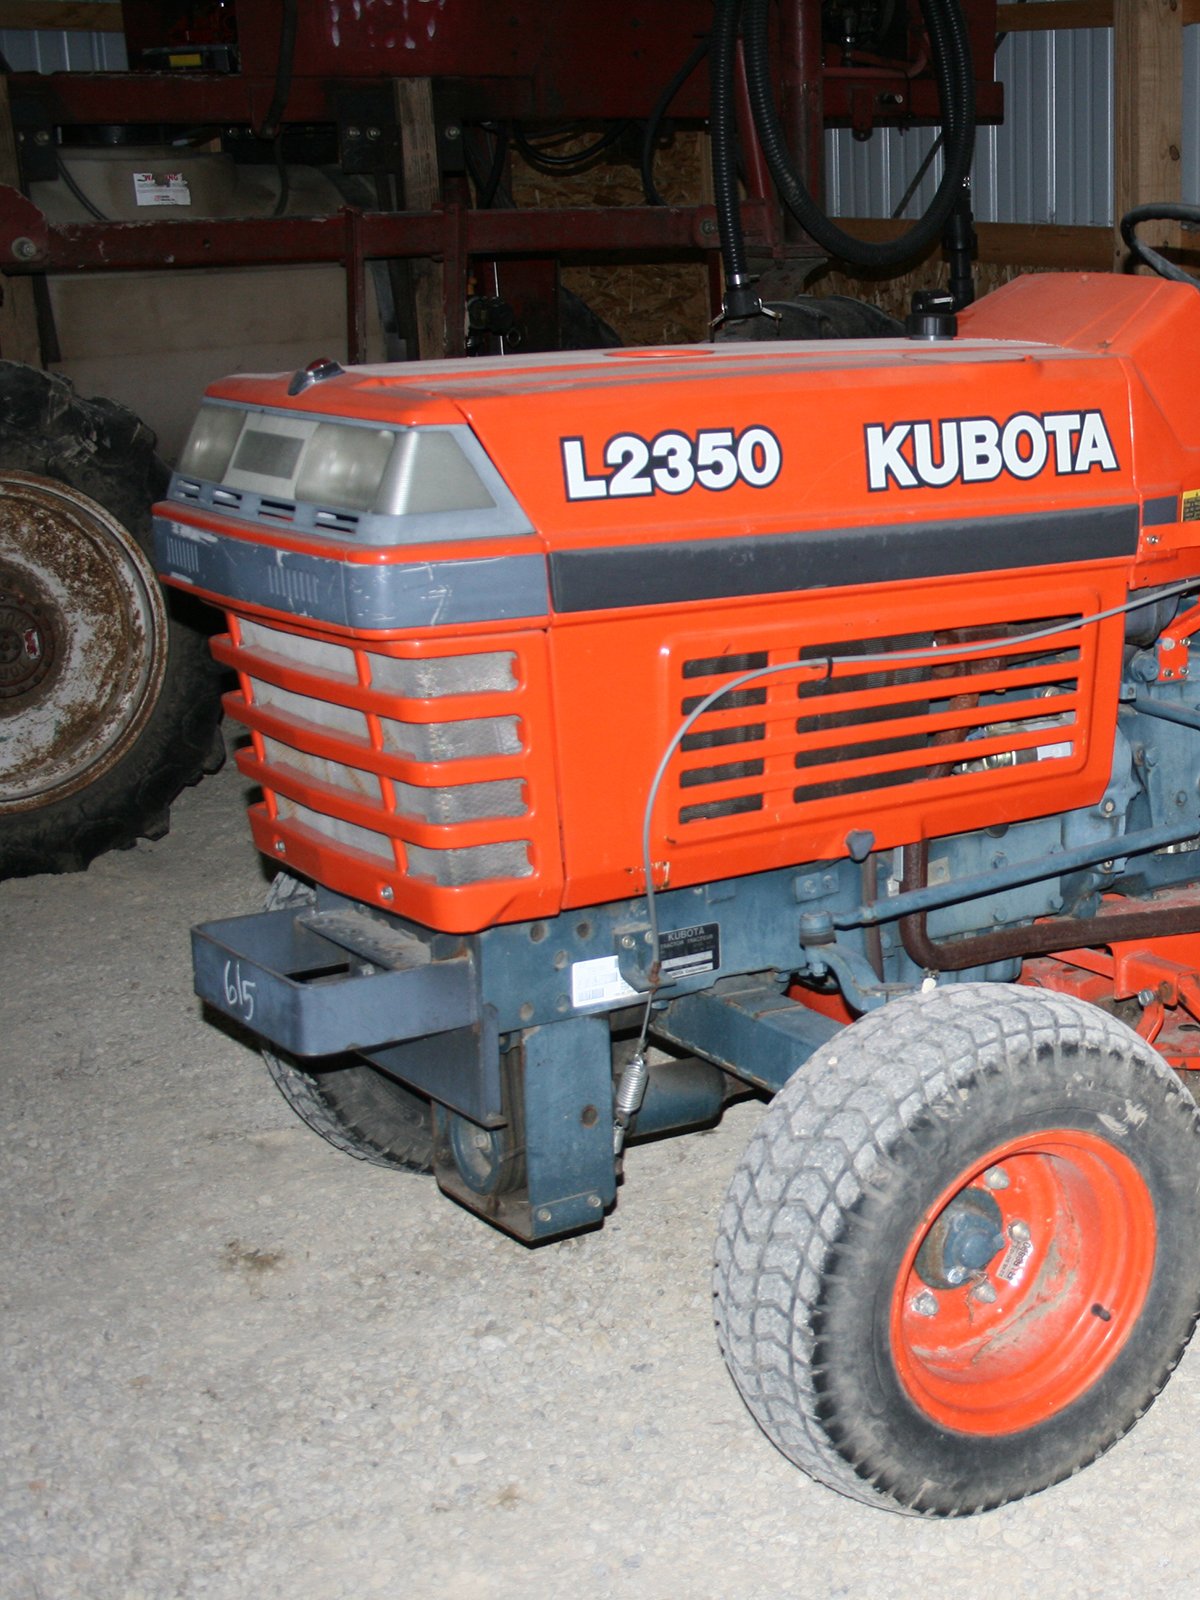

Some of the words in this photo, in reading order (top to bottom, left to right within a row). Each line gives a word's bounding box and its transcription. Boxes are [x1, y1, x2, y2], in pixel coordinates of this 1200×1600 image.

[560, 424, 783, 502] L2350
[864, 409, 1121, 492] KUBOTA
[668, 926, 705, 941] KUBOTA
[224, 960, 256, 1021] 615
